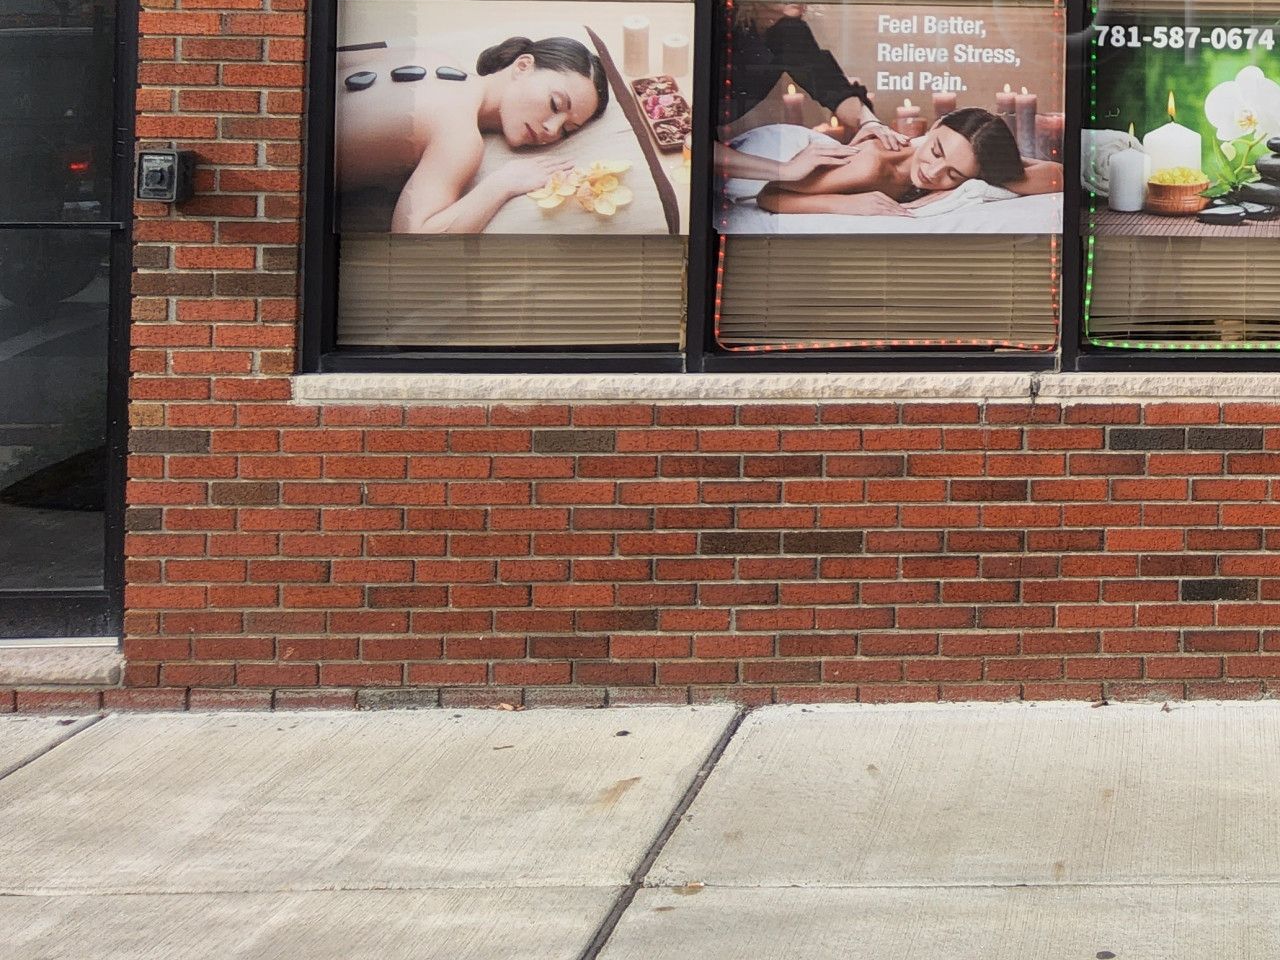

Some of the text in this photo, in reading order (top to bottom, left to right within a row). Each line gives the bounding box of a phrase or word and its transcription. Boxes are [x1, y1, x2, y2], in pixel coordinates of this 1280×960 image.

[878, 14, 987, 39] Feel Better,
[1095, 25, 1276, 51] 781-587-0674
[877, 43, 1021, 68] Relieve Stress,
[876, 71, 968, 92] End Pain.
